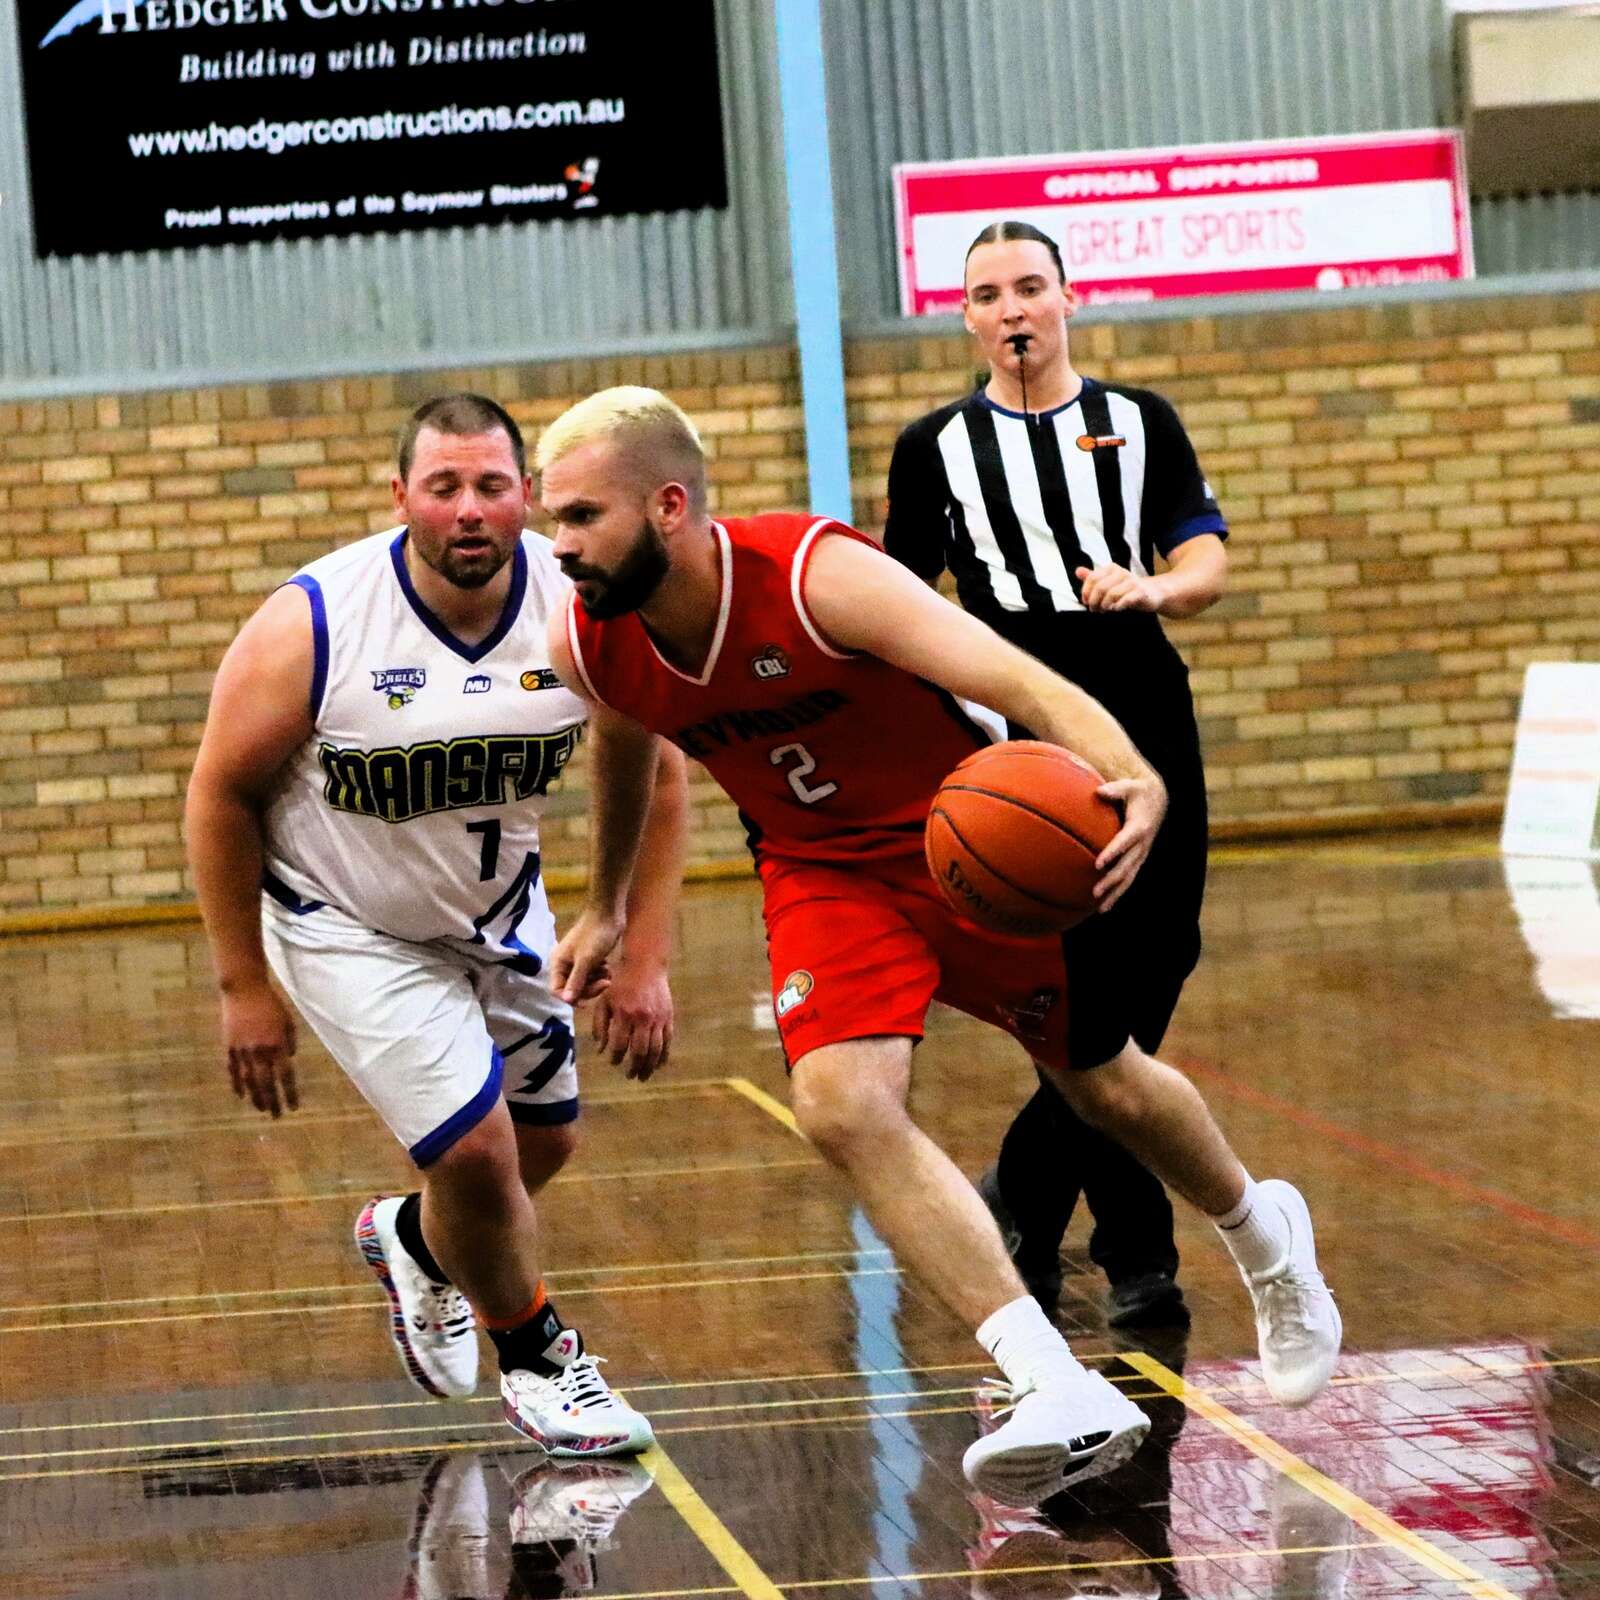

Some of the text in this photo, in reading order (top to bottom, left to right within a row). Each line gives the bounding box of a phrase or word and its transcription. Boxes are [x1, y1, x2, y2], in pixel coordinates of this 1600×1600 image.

[179, 28, 586, 83] Building with Distinction
[128, 98, 625, 158] www.hedgerconstructions.com.au
[165, 206, 221, 229] Proud
[228, 201, 330, 226] supporters
[335, 196, 356, 217] of
[363, 194, 395, 214] the
[402, 190, 484, 214] Seymour
[1044, 171, 1160, 199] OFFICIAL
[1068, 206, 1307, 267] GREAT SPORTS
[754, 658, 787, 678] CBL
[319, 722, 586, 824] MANSFIE
[769, 743, 837, 804] 2
[466, 819, 501, 882] 7
